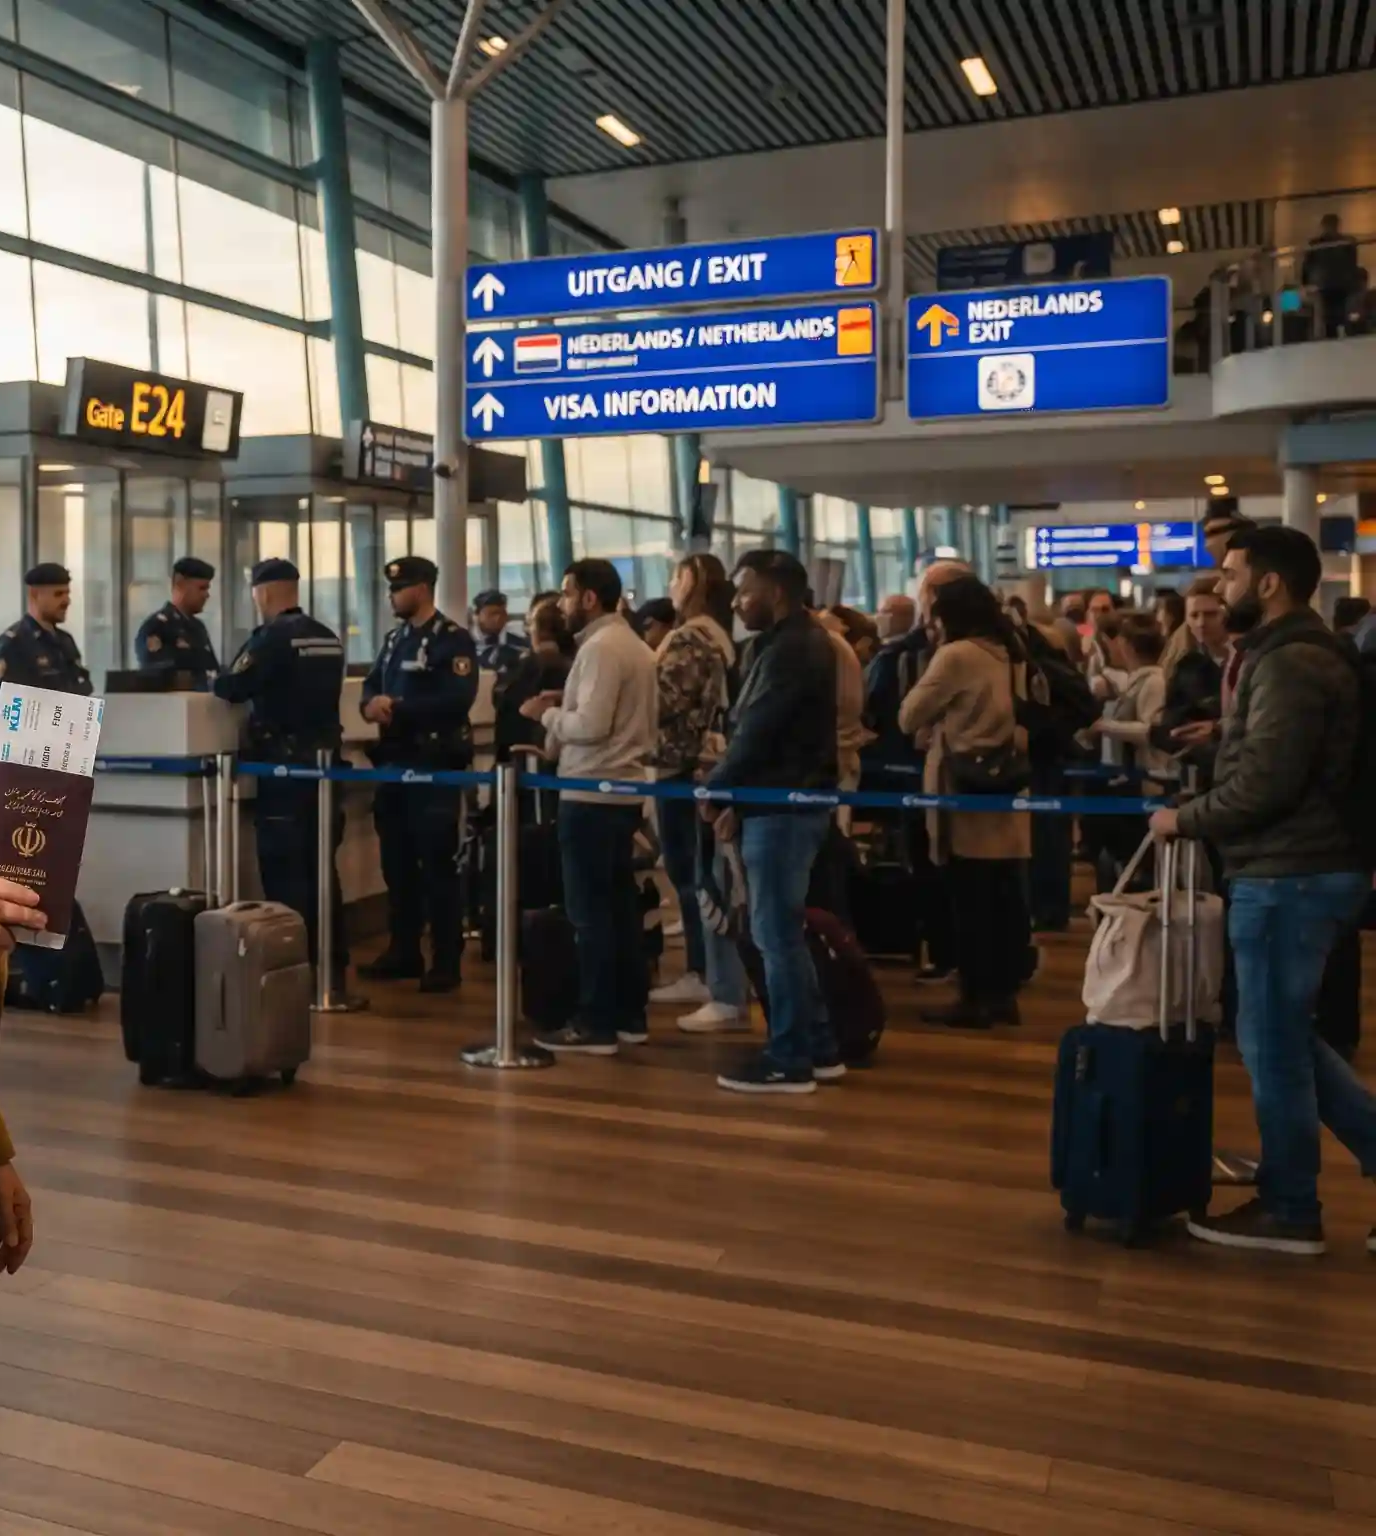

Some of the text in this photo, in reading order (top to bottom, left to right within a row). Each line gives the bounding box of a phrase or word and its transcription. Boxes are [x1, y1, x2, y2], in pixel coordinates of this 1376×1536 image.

[567, 252, 768, 297] UITGANG / EXIT
[967, 289, 1104, 321] NEDERLANDS
[567, 326, 684, 355] NEDERLANDS
[698, 316, 836, 346] NETHERLANDS
[968, 319, 1015, 344] EXIT
[85, 380, 186, 439] Gate E24
[543, 382, 777, 421] VISA INFORMATION
[9, 697, 23, 732] KLM
